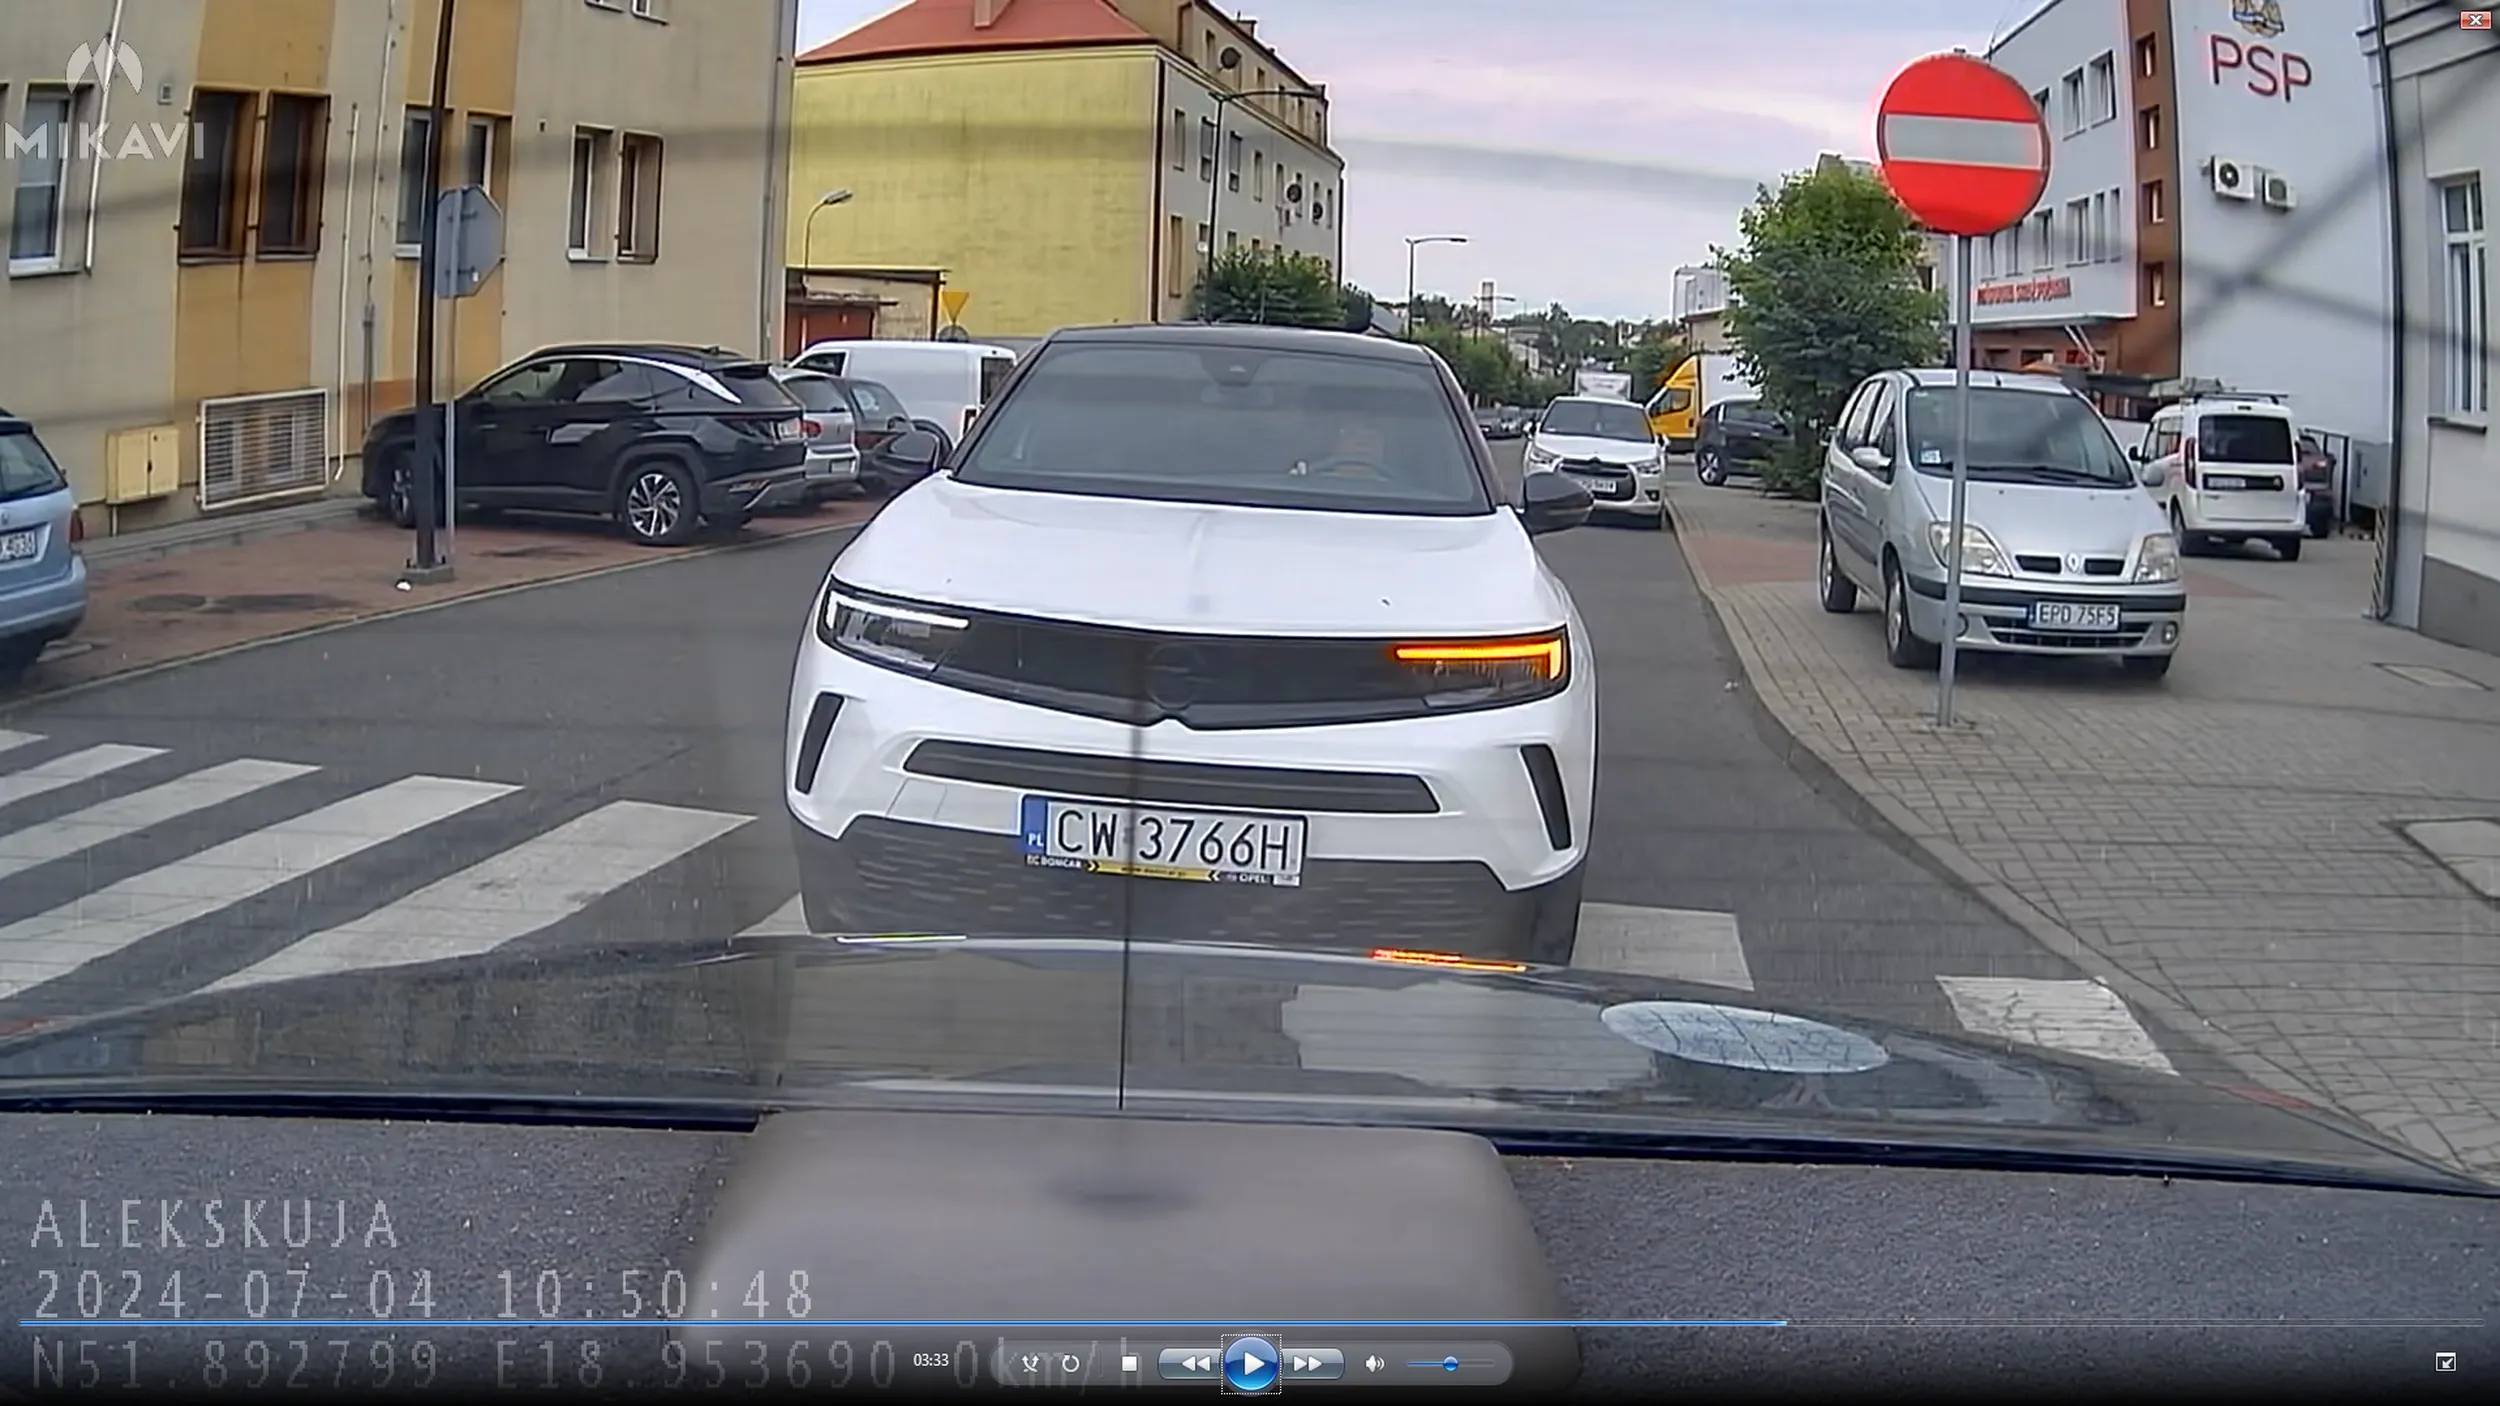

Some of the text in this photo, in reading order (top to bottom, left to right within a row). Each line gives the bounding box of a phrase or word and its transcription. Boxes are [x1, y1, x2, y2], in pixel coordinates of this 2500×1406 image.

[2210, 34, 2312, 103] PSP
[1028, 833, 1045, 847] PL
[1058, 809, 1290, 870] CW 3766H
